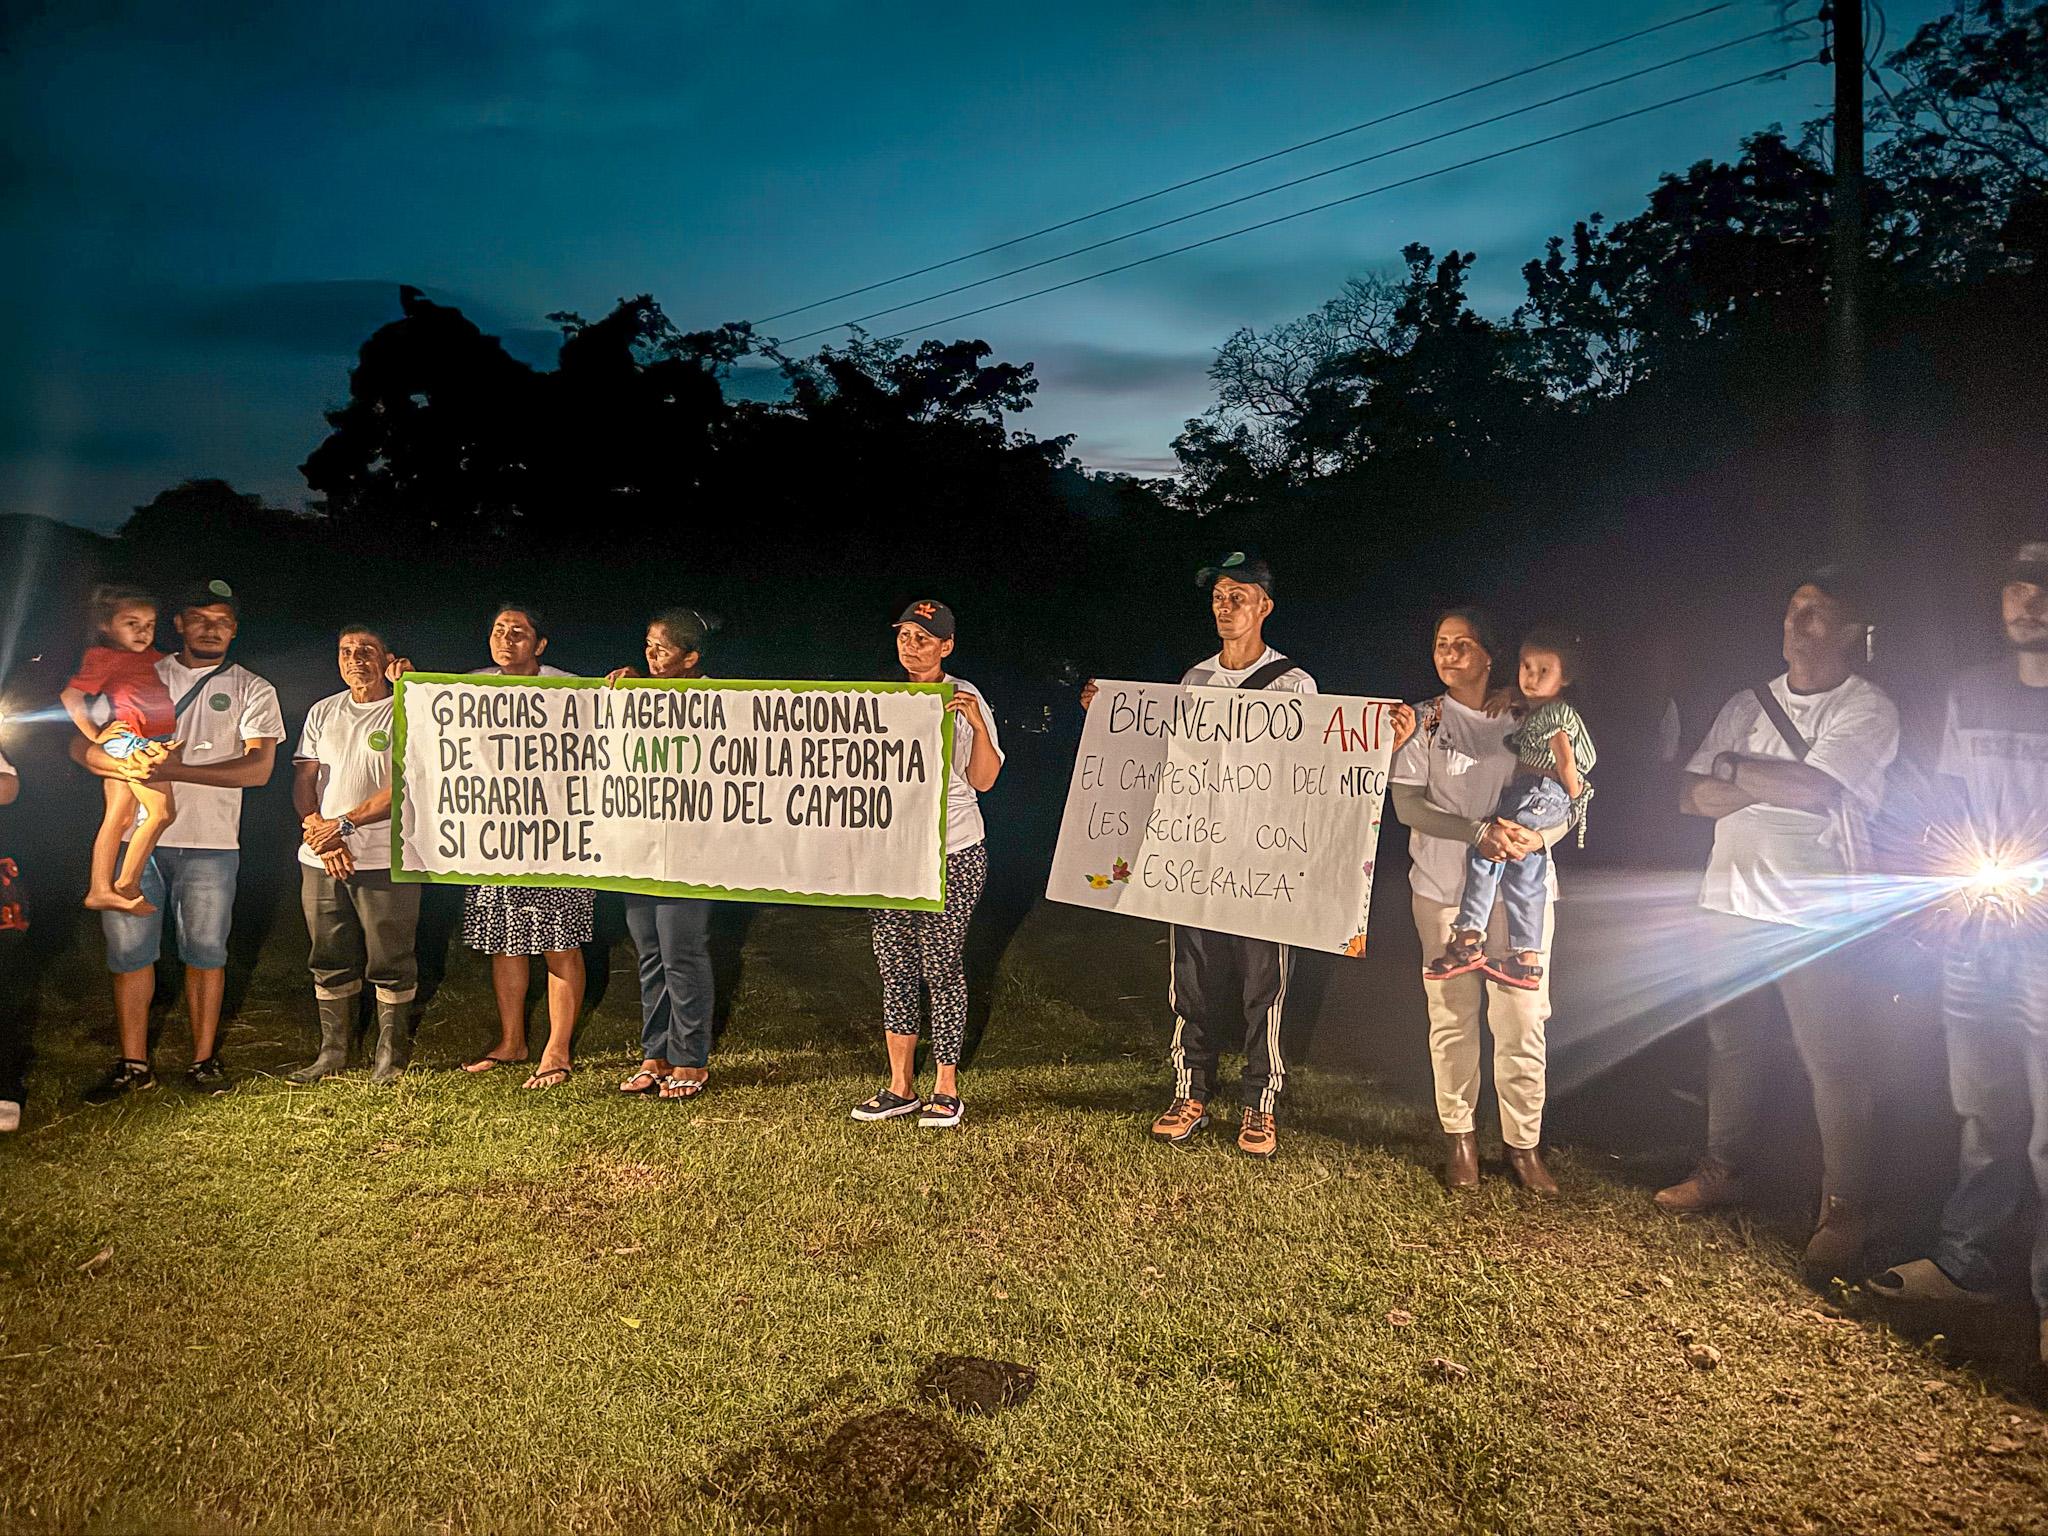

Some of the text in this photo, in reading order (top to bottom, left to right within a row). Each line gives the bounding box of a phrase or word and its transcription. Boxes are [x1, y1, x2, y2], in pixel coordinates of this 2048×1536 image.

[432, 690, 888, 736] GRACIAS A LA AGENCIA NACIONAL
[1109, 689, 1391, 752] BIENVENIDOS ANT
[439, 732, 926, 783] DE TIERRAS (ANT) CON LA REFORMA
[1120, 758, 1272, 796] CAMPESINADO
[1293, 762, 1328, 796] DEL
[1340, 766, 1385, 797] MTCC
[438, 775, 893, 830] AGRARIA EL GOBIERNO DEL CAMBIO
[1088, 802, 1308, 853] LES RECIBE CON
[438, 819, 602, 863] SI CUMPLE.
